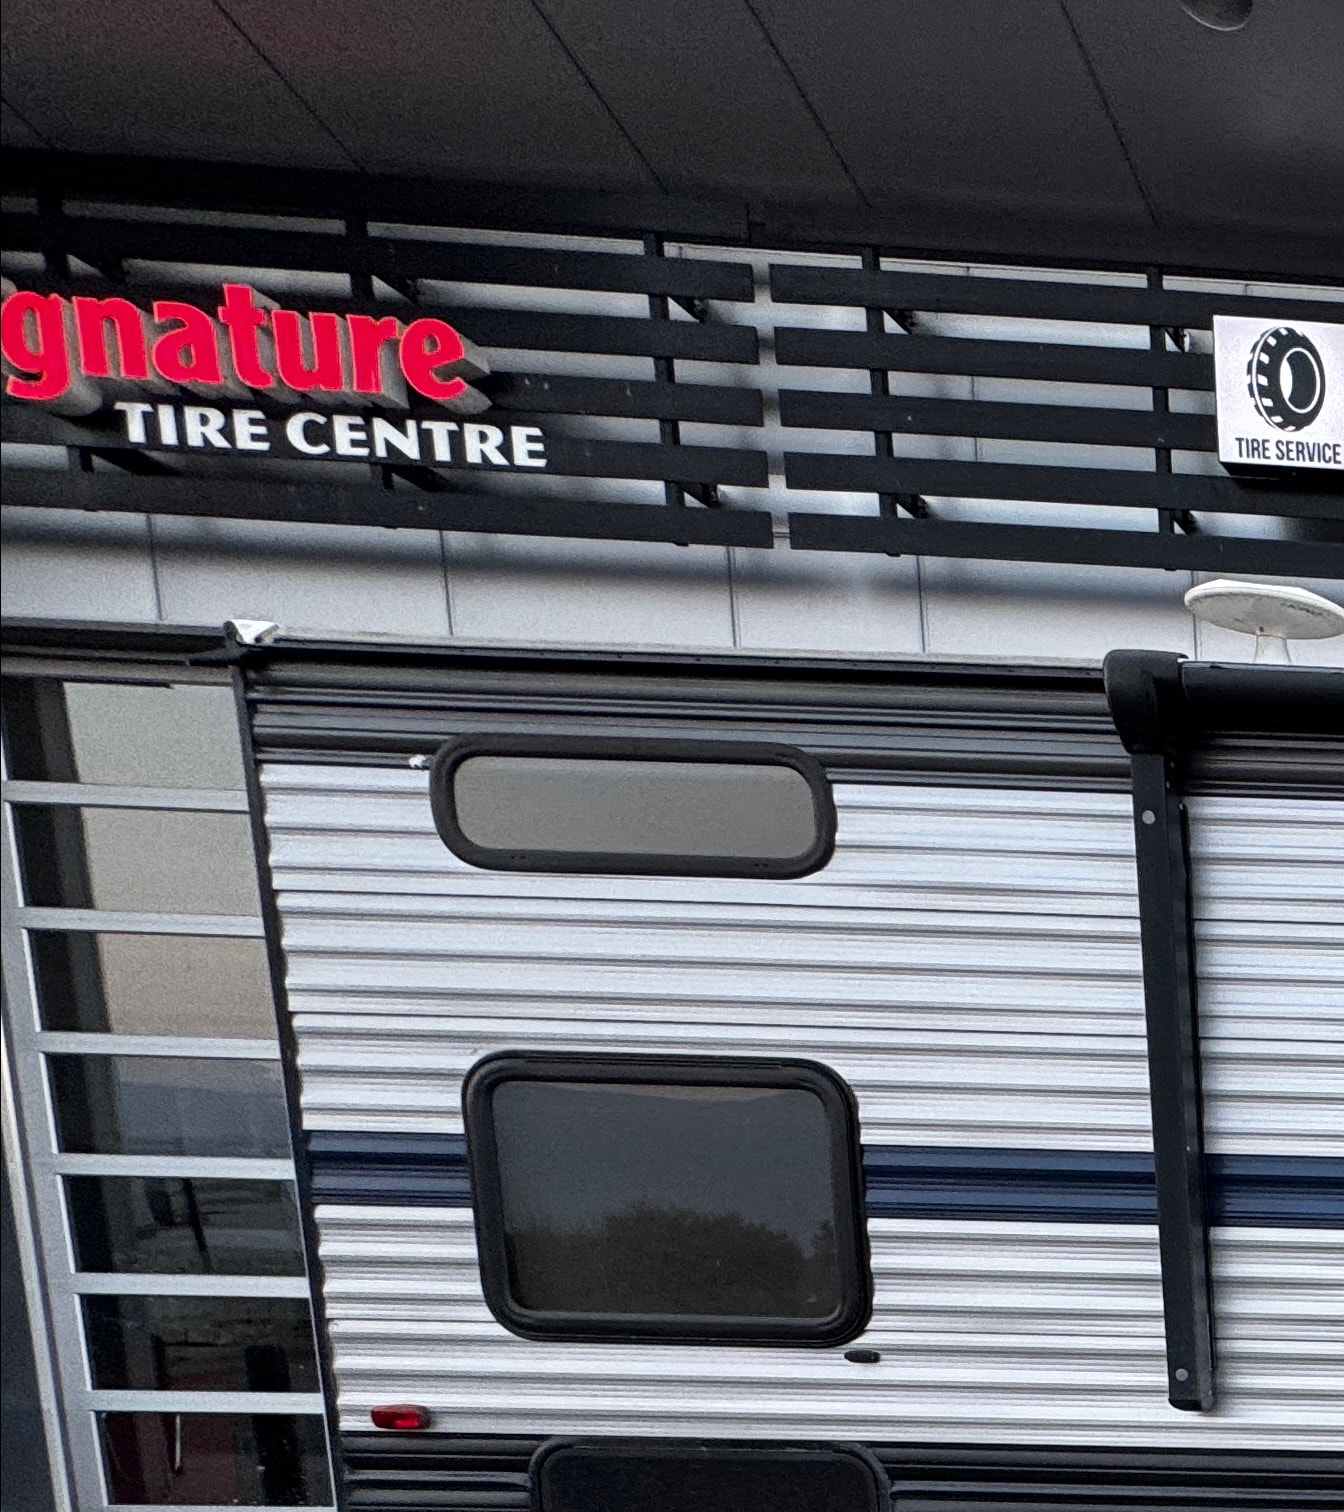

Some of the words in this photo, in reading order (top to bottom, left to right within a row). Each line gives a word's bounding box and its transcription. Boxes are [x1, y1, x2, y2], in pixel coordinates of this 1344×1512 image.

[114, 401, 271, 452] TIRE
[285, 410, 549, 468] CENTRE
[1235, 437, 1272, 460] TIRE
[1275, 440, 1342, 465] SERVICE
